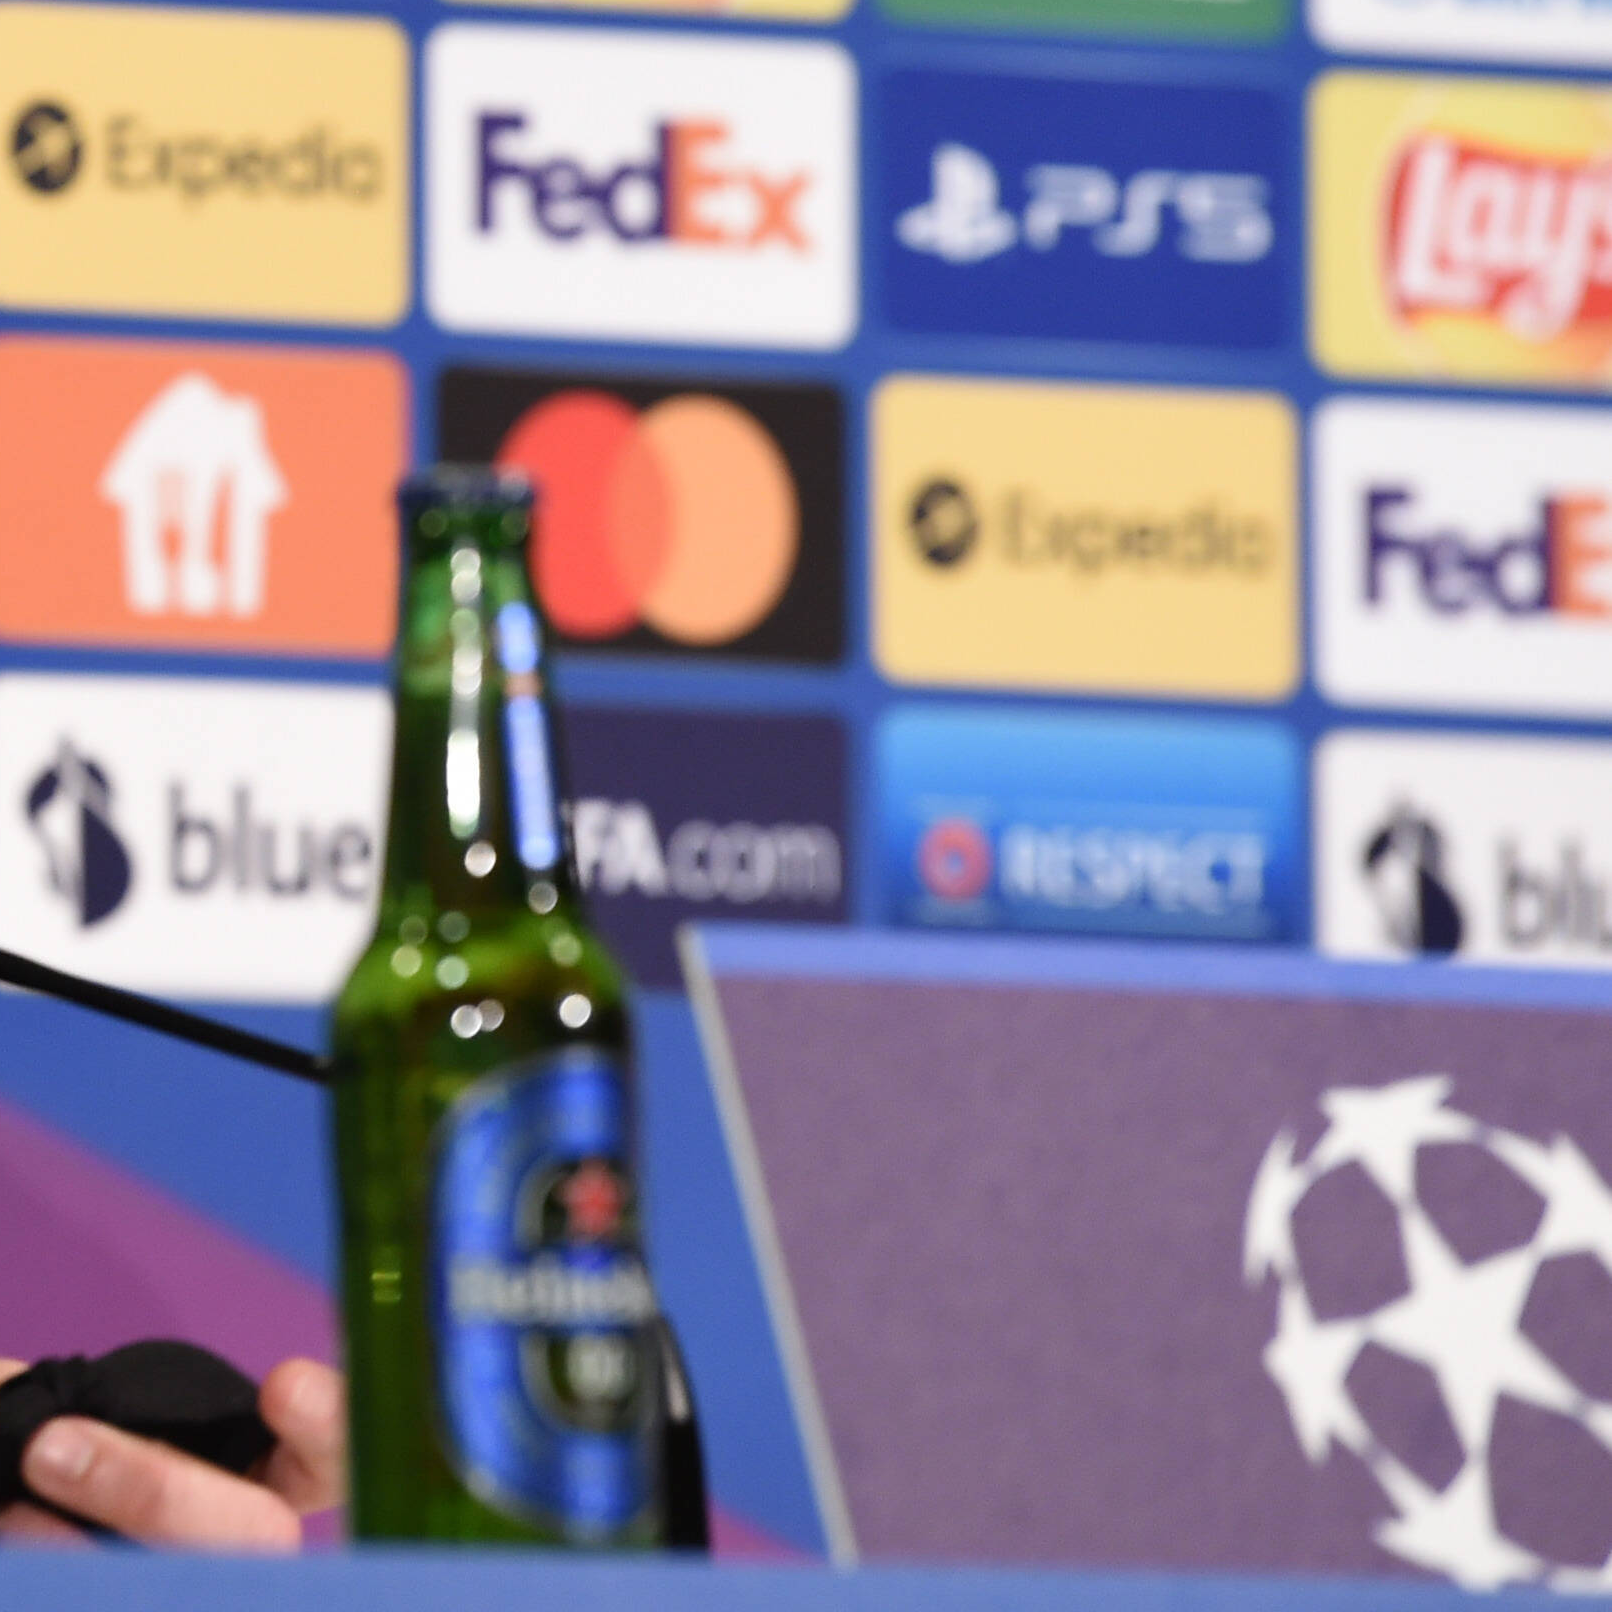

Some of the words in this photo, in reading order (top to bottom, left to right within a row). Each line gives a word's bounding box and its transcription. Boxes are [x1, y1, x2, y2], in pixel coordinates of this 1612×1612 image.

[102, 112, 385, 205] Expedia
[472, 108, 811, 252] FedEx
[1022, 164, 1275, 263] PS5
[1360, 483, 1612, 621] FedE
[167, 782, 377, 901] blue
